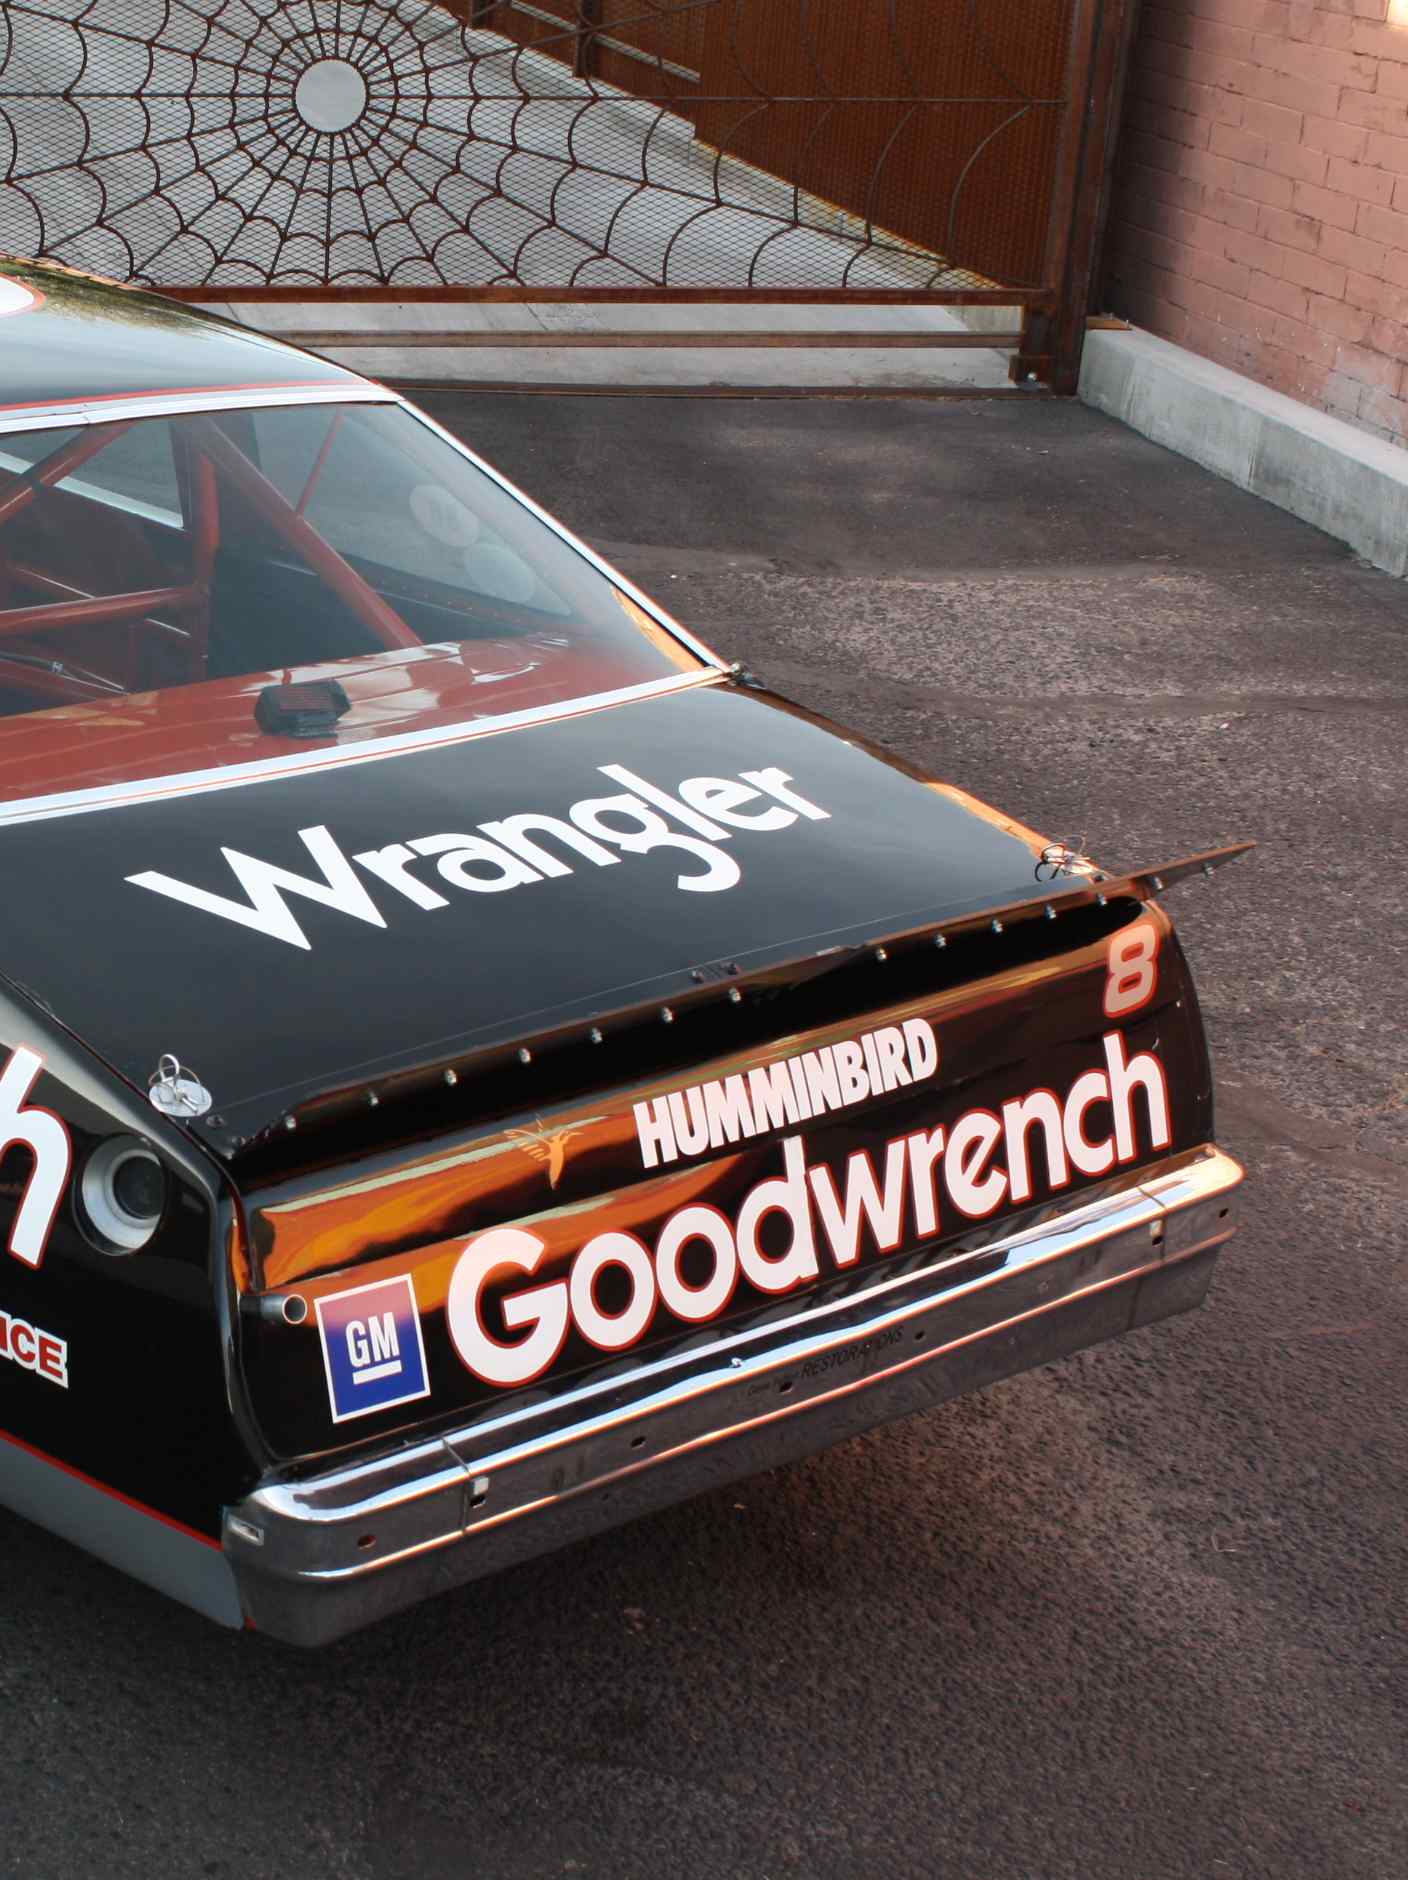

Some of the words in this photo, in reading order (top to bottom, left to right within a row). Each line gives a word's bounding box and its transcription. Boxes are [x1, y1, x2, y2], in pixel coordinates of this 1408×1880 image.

[123, 764, 832, 950] Wrangler
[1103, 923, 1160, 1017] 8
[633, 1018, 937, 1168] HUMMINBIRD
[446, 1031, 1171, 1388] Goodwrench
[345, 1311, 400, 1368] GM
[800, 1325, 904, 1379] RESTORAONS
